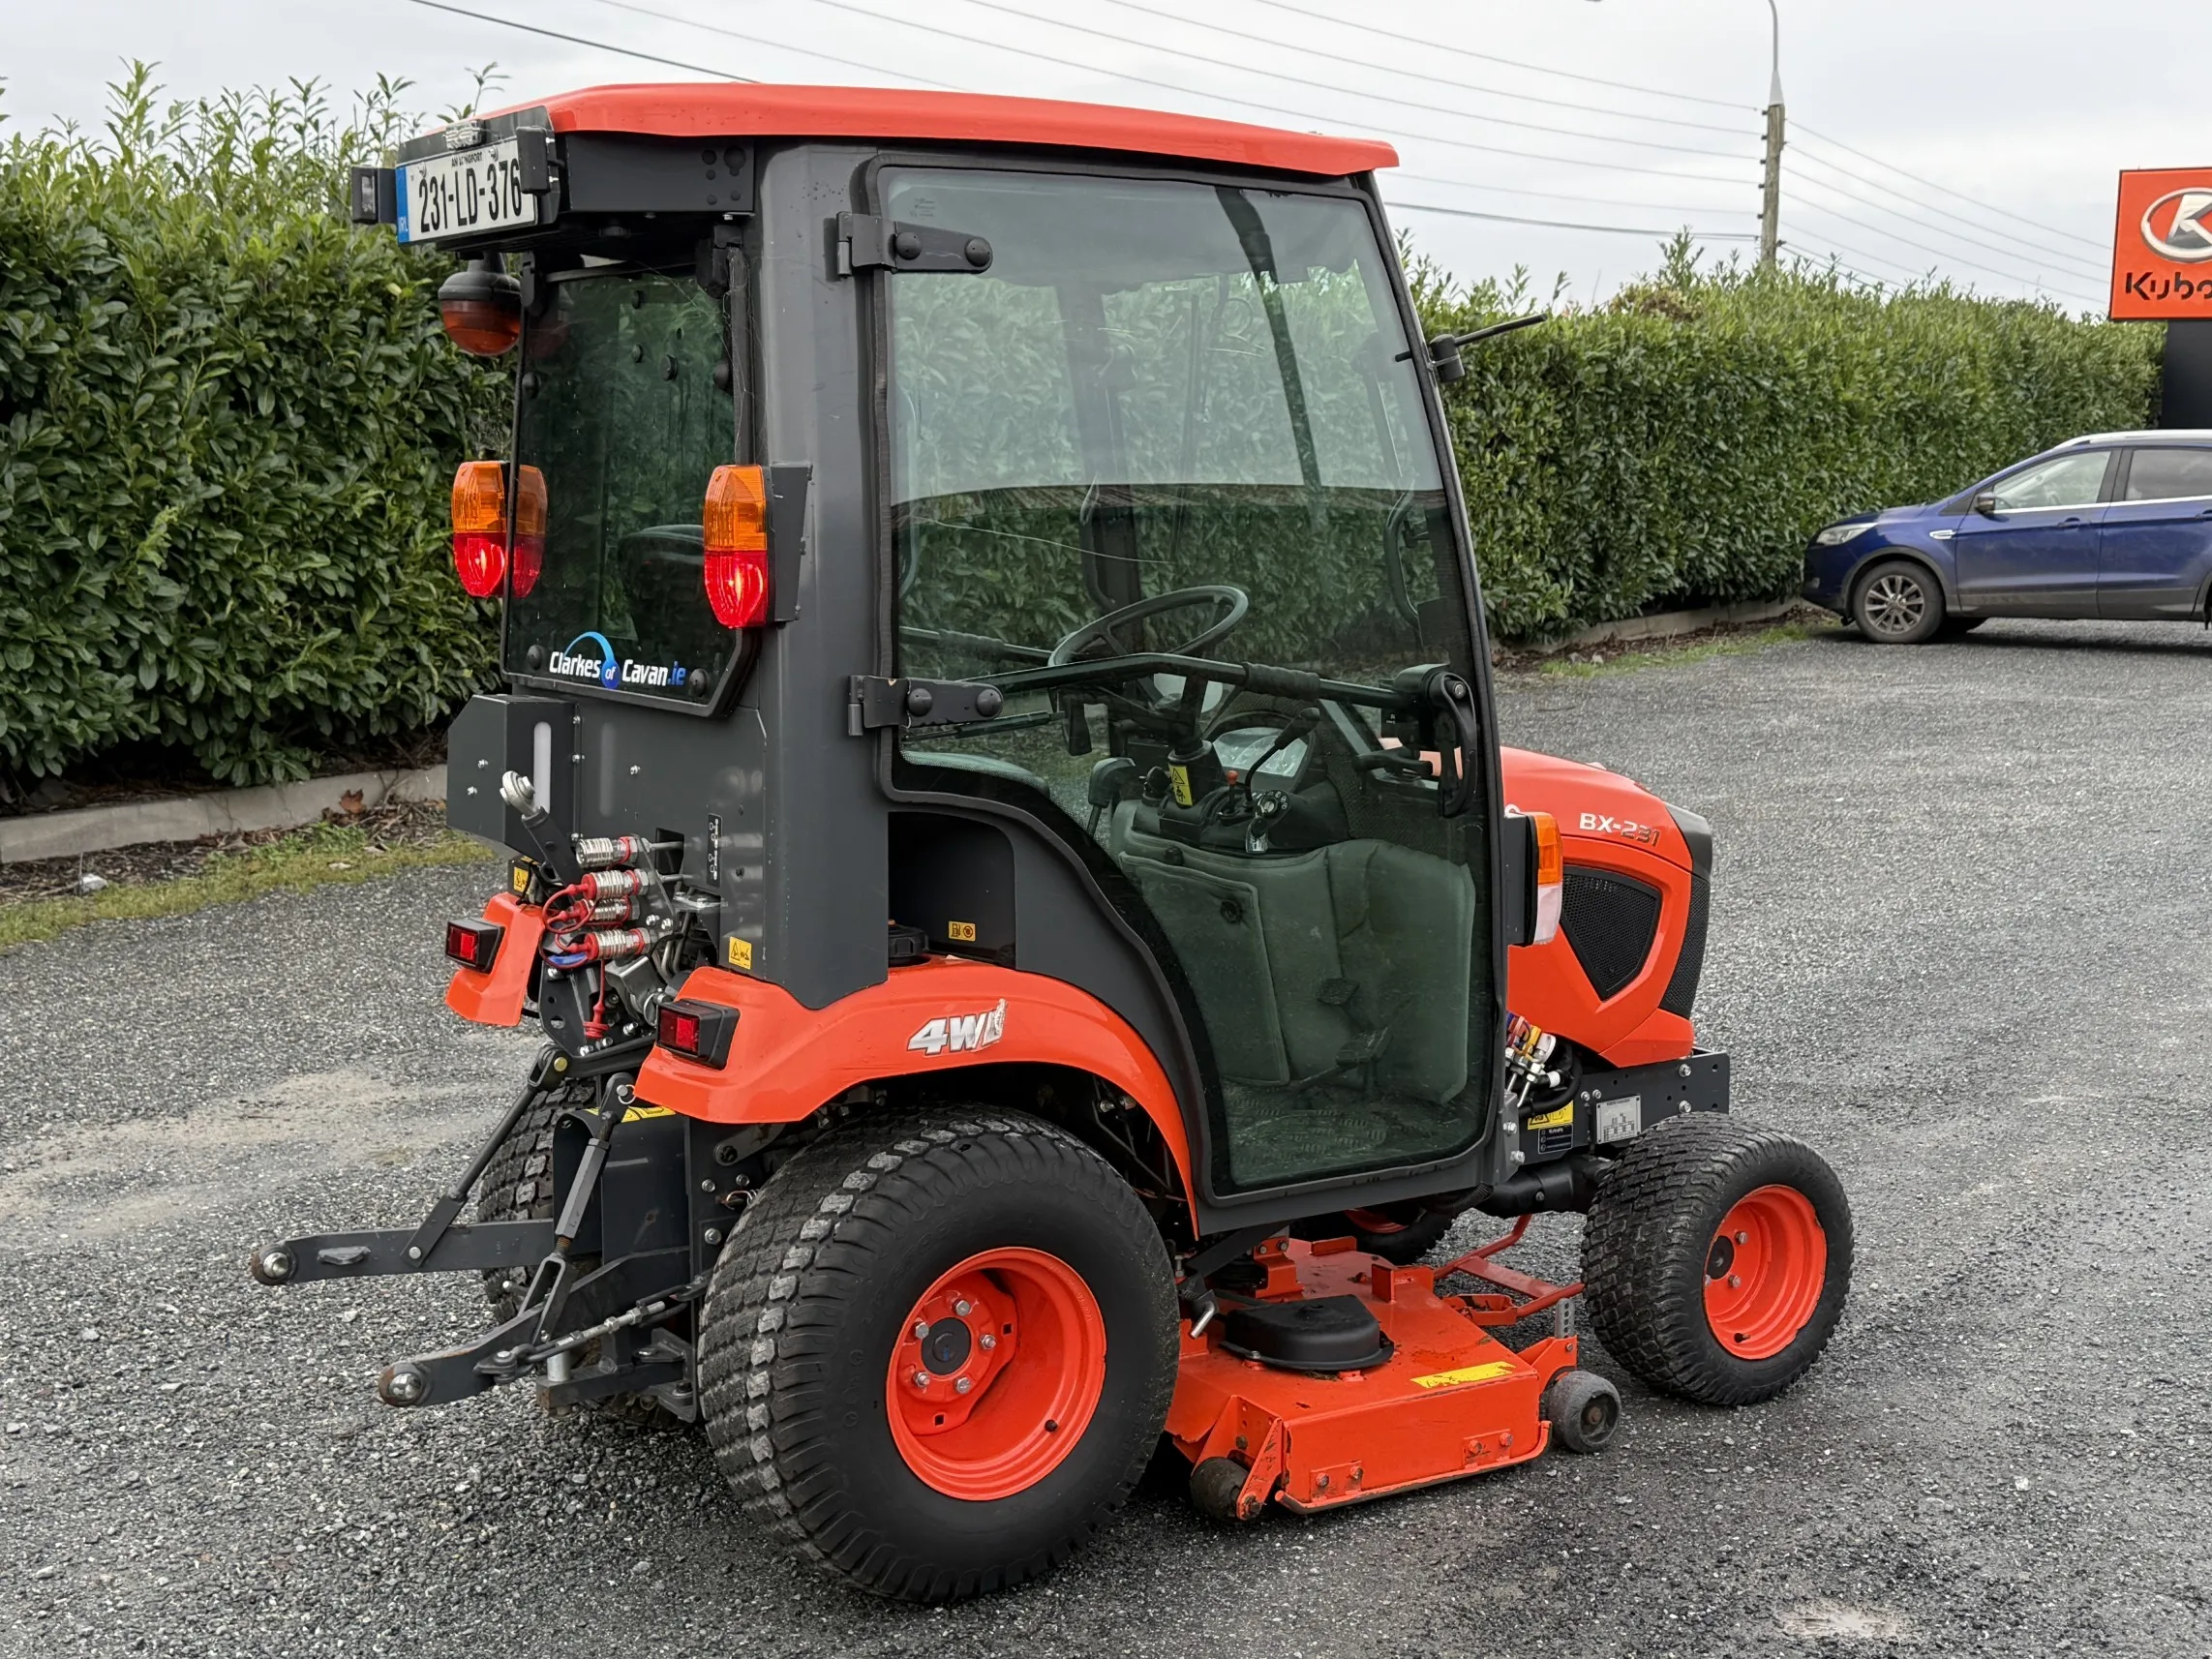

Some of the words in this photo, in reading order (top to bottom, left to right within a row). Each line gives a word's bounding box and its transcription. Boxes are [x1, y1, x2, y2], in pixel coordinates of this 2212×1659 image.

[418, 158, 522, 233] 231-LD-376
[549, 651, 601, 679] Clarkes
[605, 666, 616, 679] of
[1579, 812, 1661, 847] BX-231
